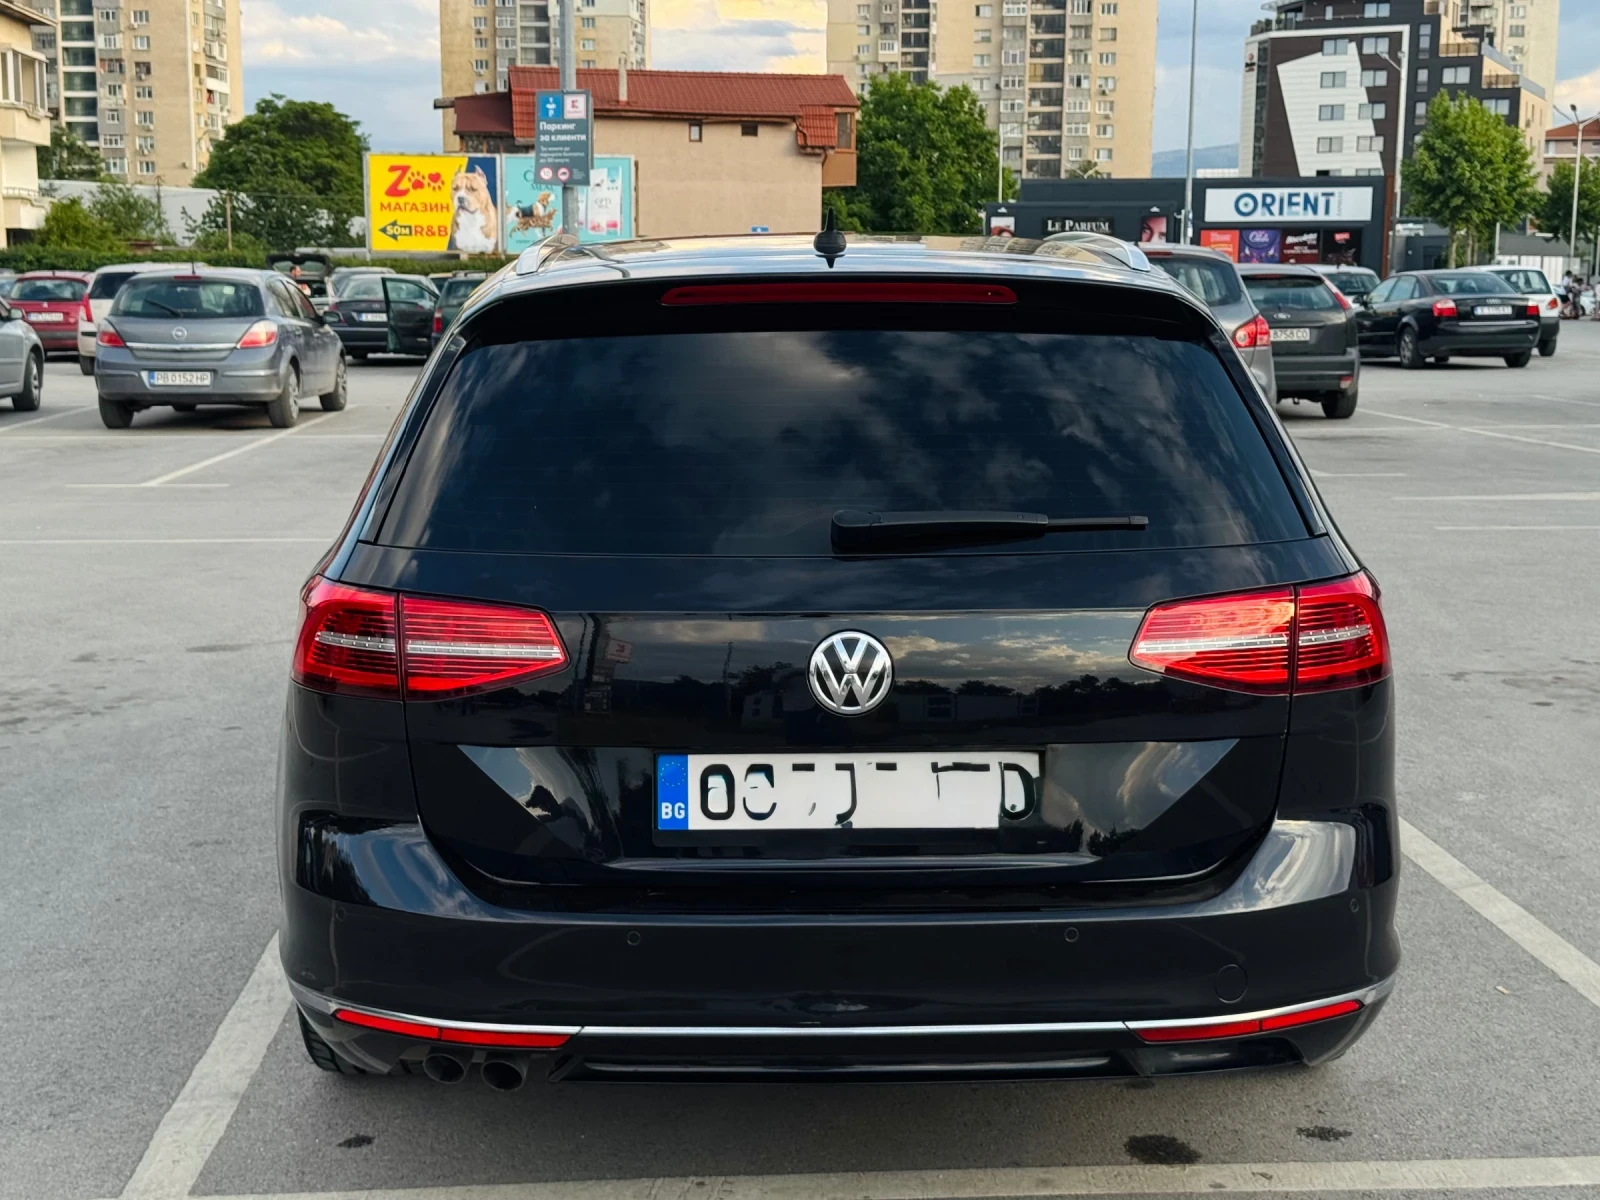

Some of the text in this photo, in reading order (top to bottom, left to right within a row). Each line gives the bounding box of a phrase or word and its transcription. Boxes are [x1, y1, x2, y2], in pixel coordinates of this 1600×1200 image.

[539, 122, 576, 132] Паркинг
[380, 202, 450, 212] МАГАЗИН
[1234, 192, 1335, 217] ORIENT
[414, 225, 448, 237] R&B
[661, 802, 686, 819] BG
